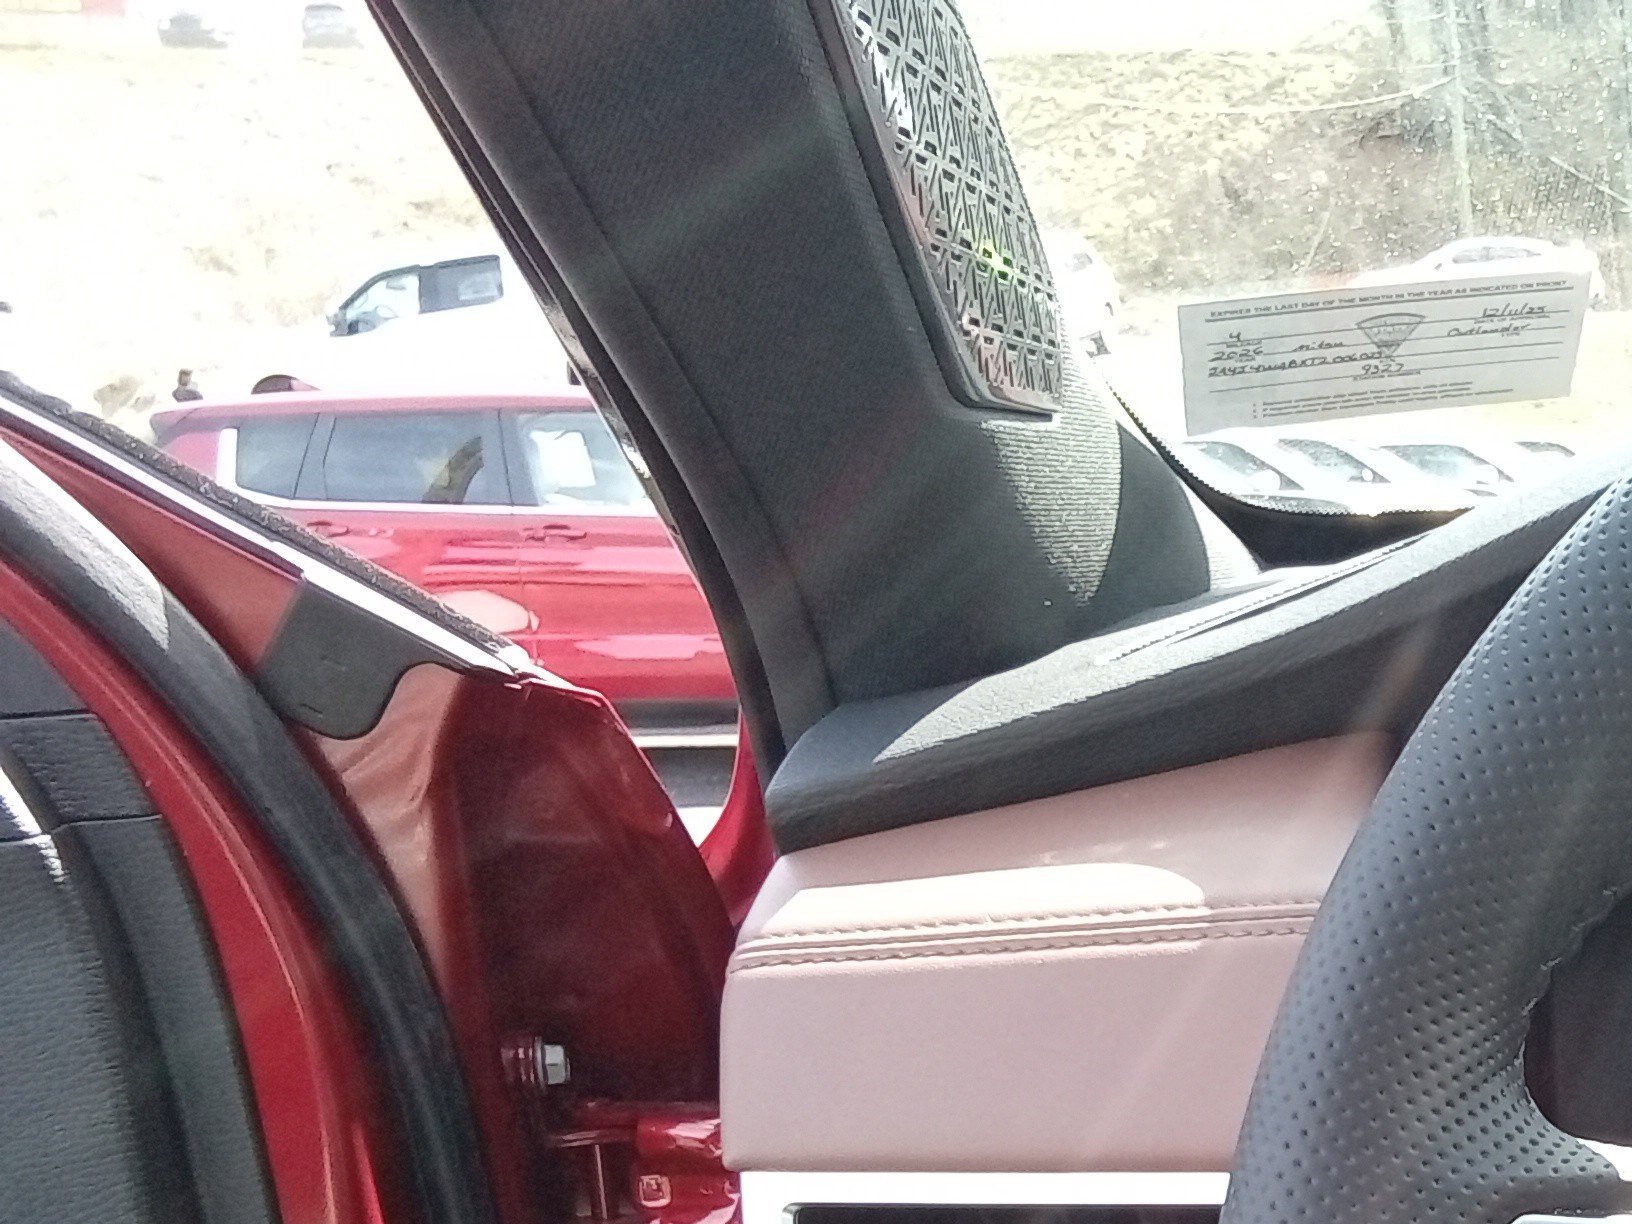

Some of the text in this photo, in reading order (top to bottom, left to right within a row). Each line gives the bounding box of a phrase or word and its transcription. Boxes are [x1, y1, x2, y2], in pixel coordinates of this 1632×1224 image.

[1254, 306, 1271, 314] THE
[1275, 303, 1299, 311] LAST
[1407, 290, 1426, 298] THE
[1428, 288, 1452, 297] YEAR
[1208, 348, 1264, 362] 2026
